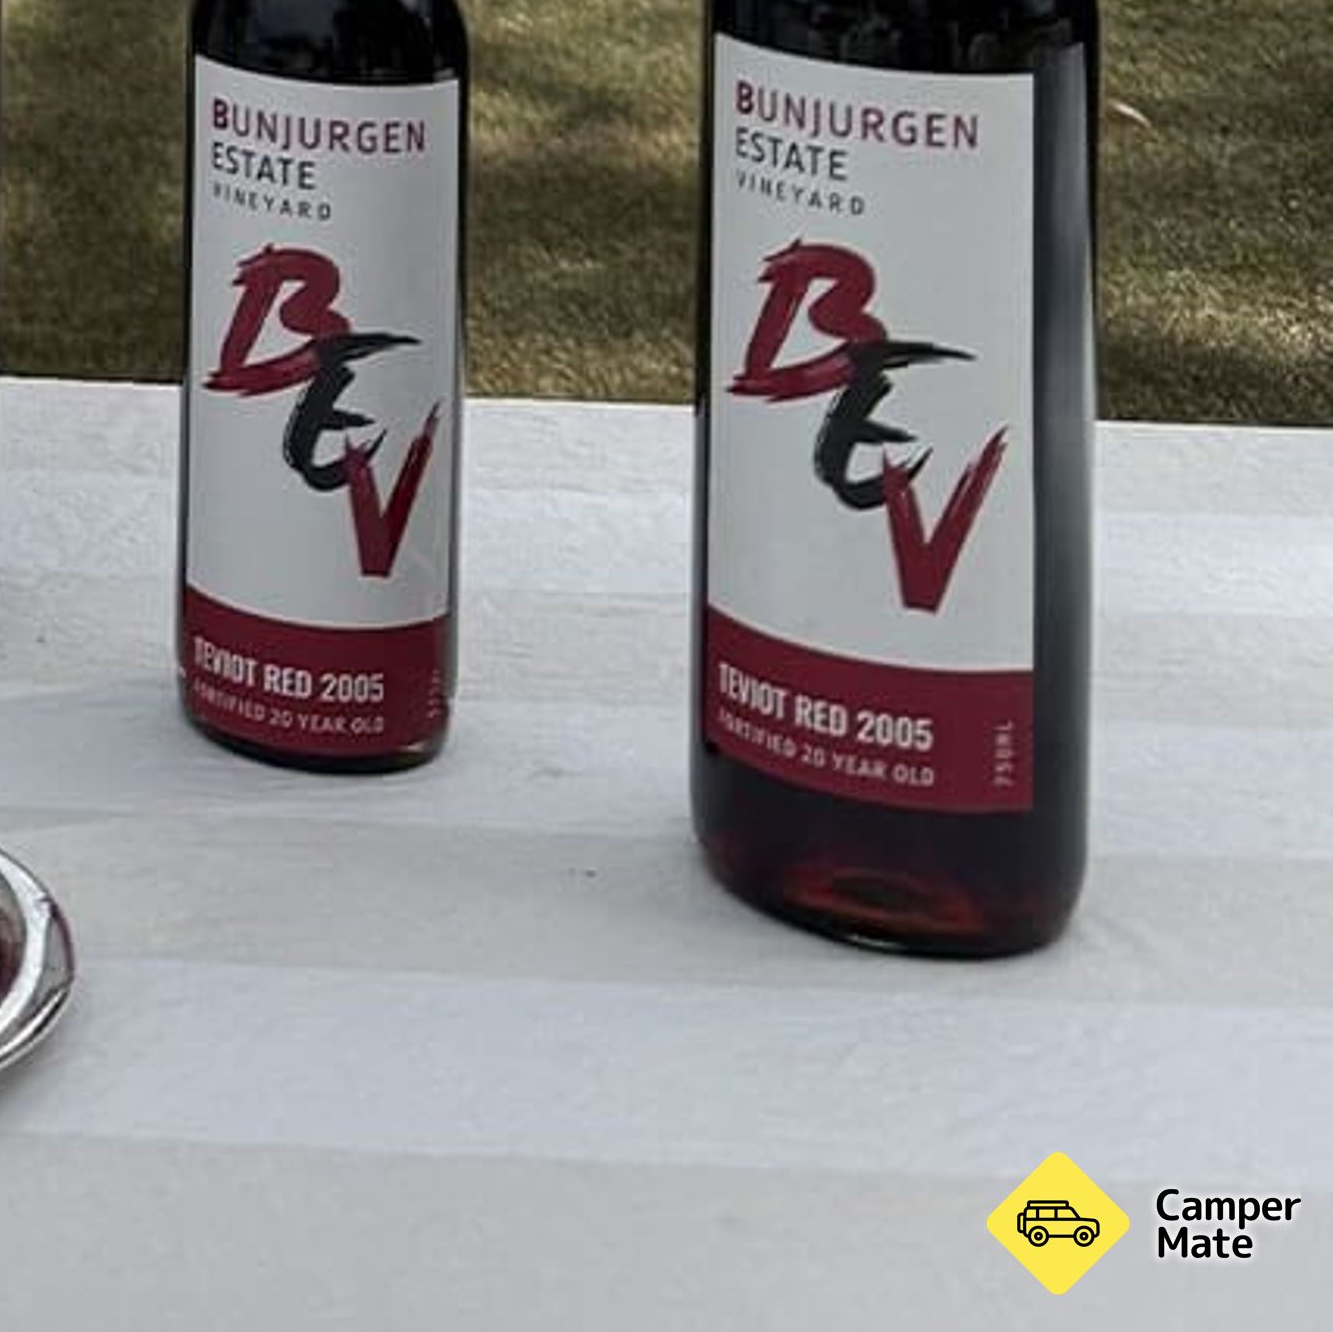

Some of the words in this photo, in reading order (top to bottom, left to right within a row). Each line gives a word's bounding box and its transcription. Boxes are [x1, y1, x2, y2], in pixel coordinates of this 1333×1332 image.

[212, 98, 426, 154] BUNJURGEN
[735, 81, 980, 148] BUNJURGEN
[211, 142, 317, 190] ESTATE
[735, 127, 848, 181] ESTATE
[212, 182, 332, 220] VINEYARD
[735, 171, 865, 216] VINEYARD
[193, 636, 258, 686] TEVIOT
[264, 664, 313, 699] RED
[319, 673, 384, 702] 2005
[719, 662, 786, 718] TEVIOT
[794, 695, 848, 738] RED
[856, 710, 933, 751] 2005
[802, 742, 827, 767] 20
[832, 753, 887, 780] YEAR
[892, 763, 934, 787] OLD
